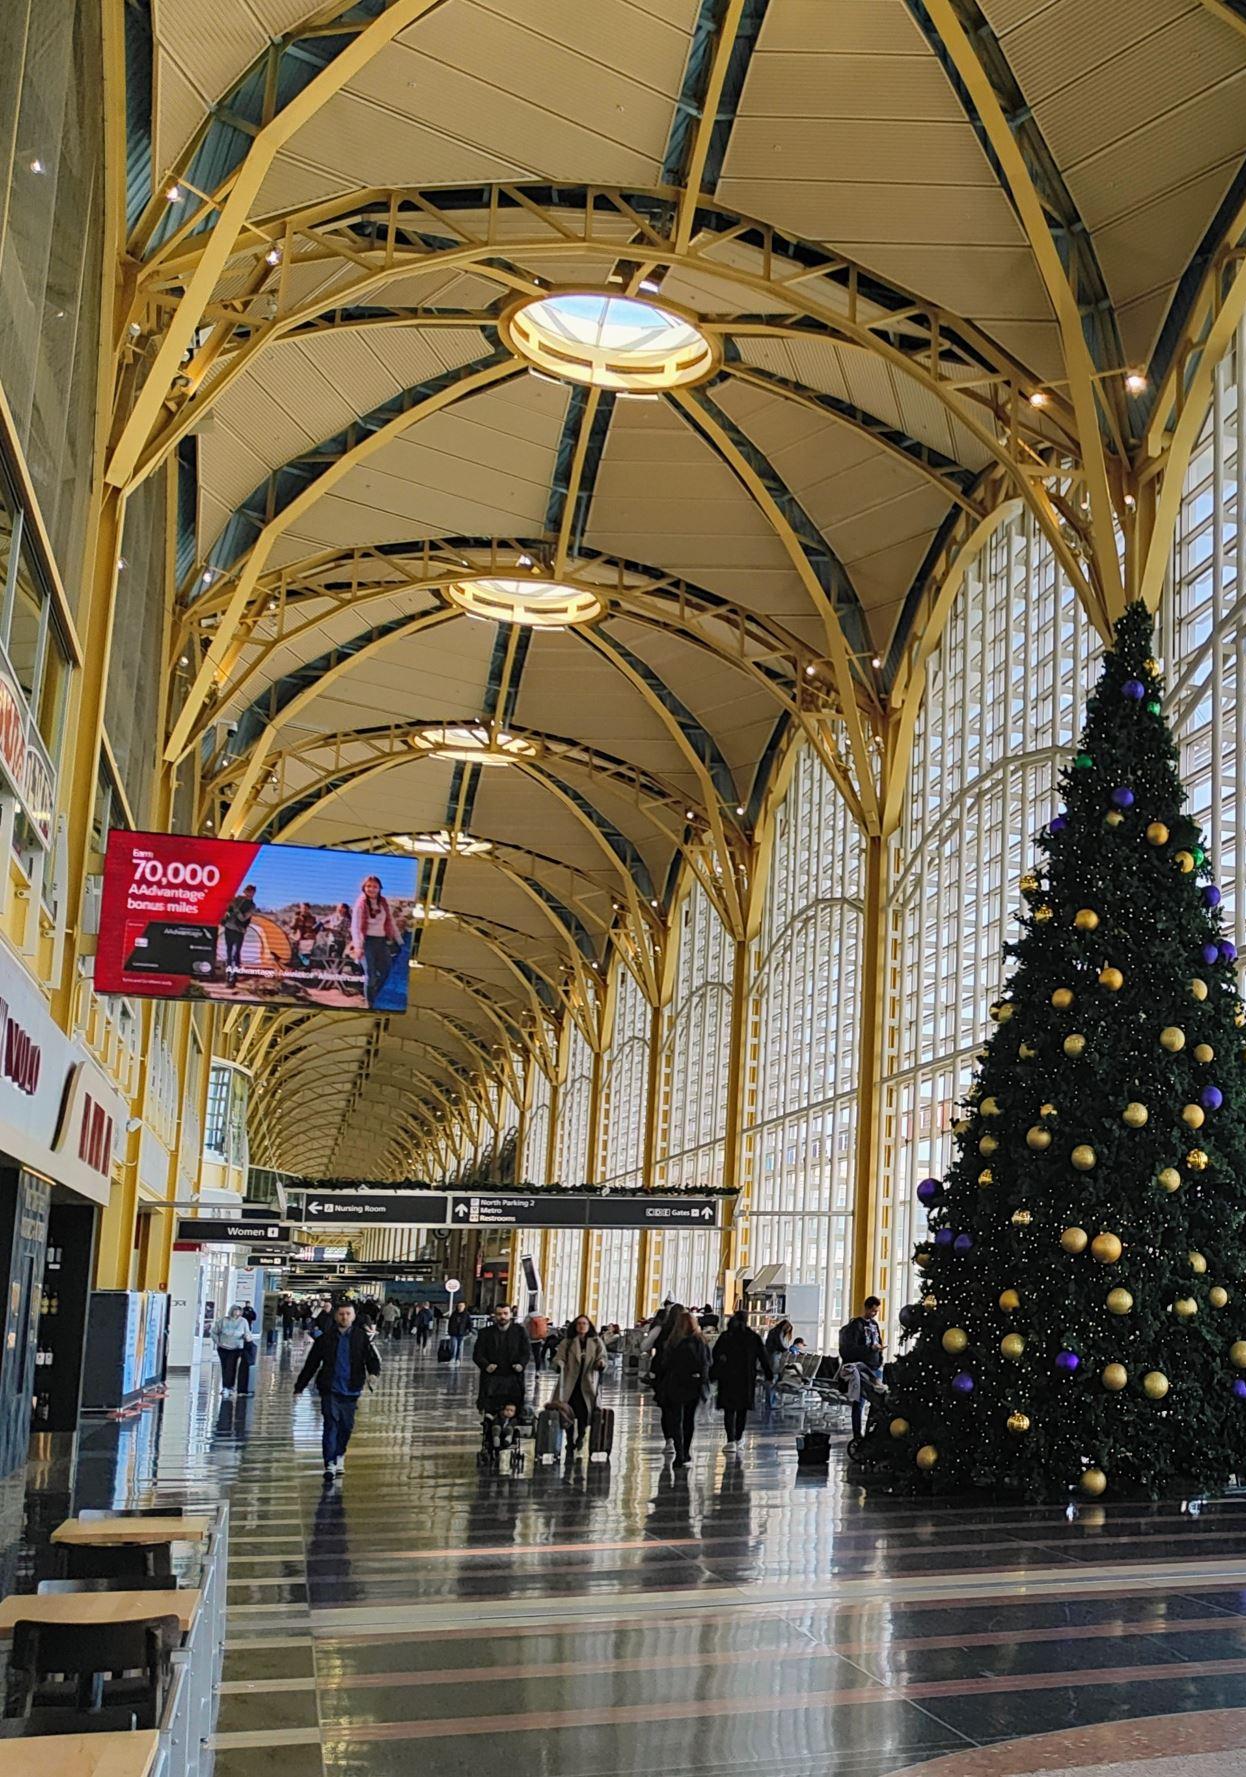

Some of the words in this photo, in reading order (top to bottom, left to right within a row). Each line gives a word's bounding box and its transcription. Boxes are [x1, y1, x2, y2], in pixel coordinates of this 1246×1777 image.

[132, 848, 154, 858] Earn
[131, 858, 221, 887] 70,000
[127, 897, 165, 912] bonus
[167, 901, 199, 914] miles
[502, 1199, 529, 1208] Parking
[334, 1204, 363, 1214] Nursing
[364, 1205, 387, 1213] Room
[480, 1214, 517, 1222] Restrooms
[227, 1227, 266, 1237] Women
